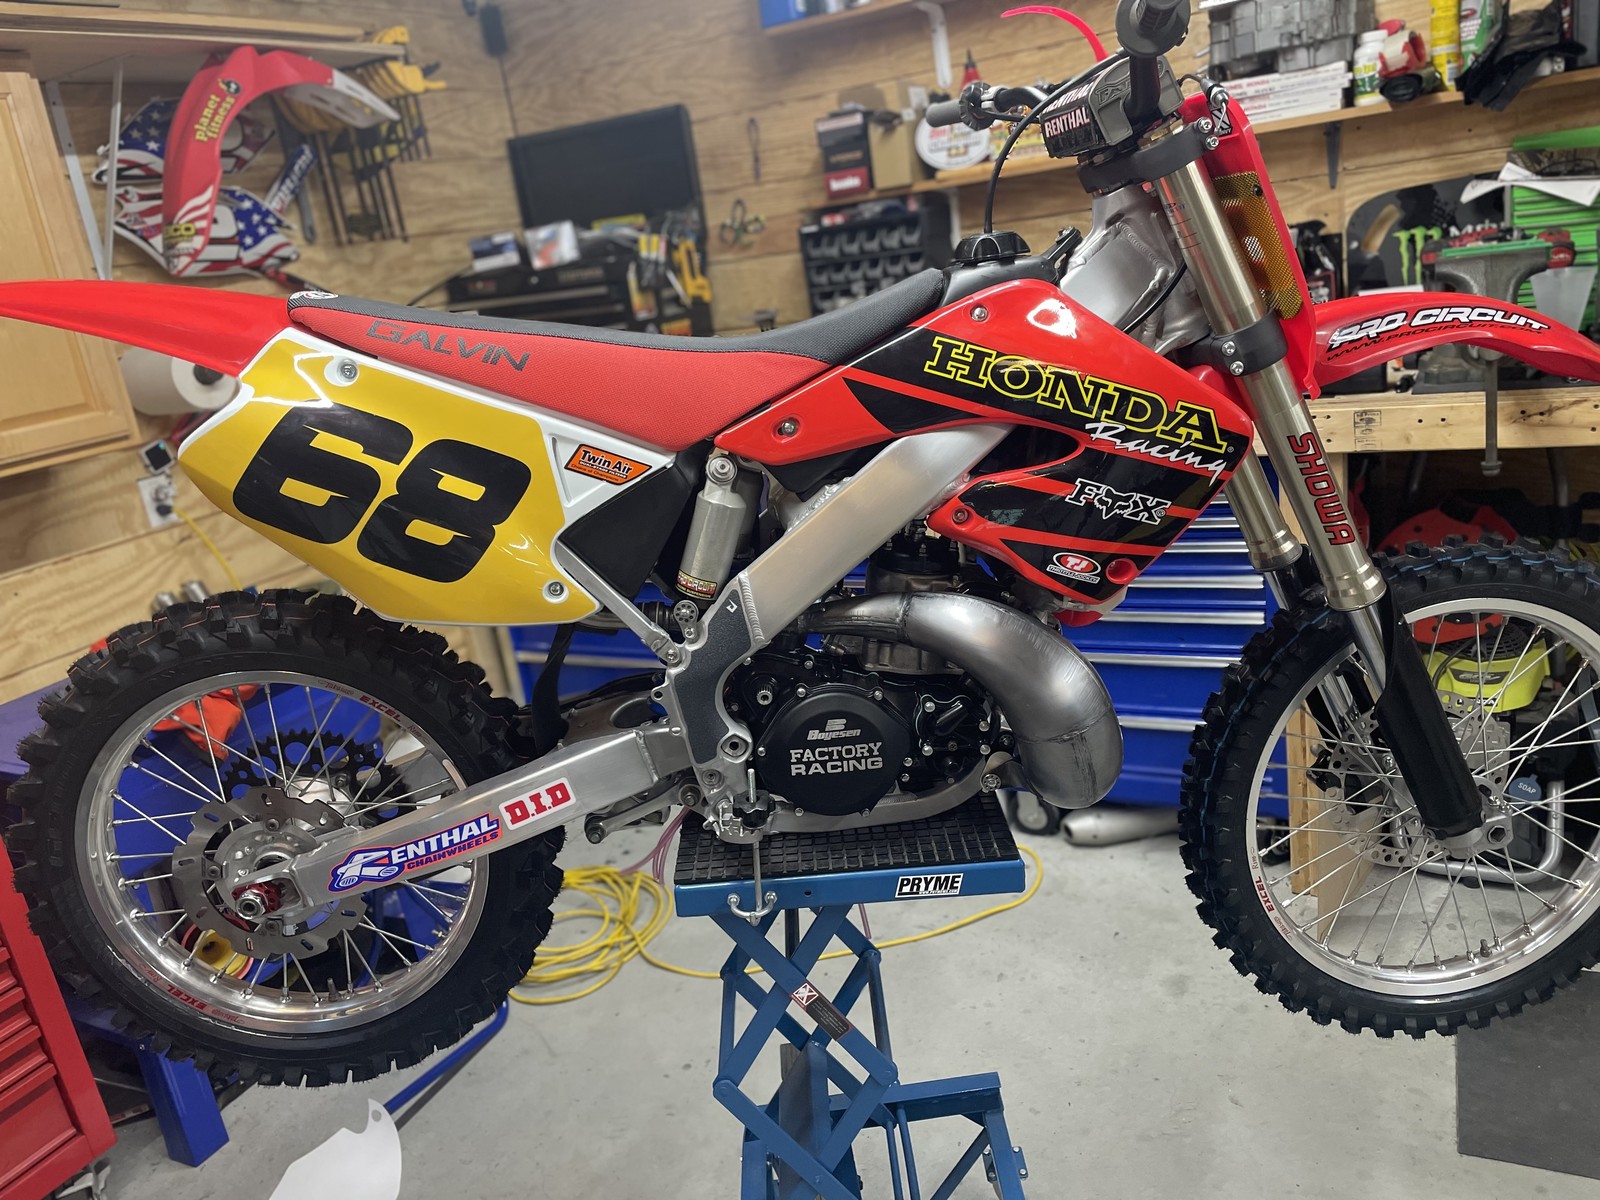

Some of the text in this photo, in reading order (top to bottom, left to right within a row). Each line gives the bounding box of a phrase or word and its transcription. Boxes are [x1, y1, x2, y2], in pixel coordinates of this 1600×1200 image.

[1044, 106, 1090, 138] RENTHAL
[1411, 307, 1549, 331] CIRCUIT
[366, 320, 530, 371] GALVIN
[924, 336, 1227, 453] HONDA
[581, 450, 633, 475] Twin Air
[1085, 422, 1229, 487] Racing
[232, 399, 532, 583] 68
[1287, 432, 1355, 545] SHOWA
[1066, 556, 1090, 570] TJ
[360, 695, 401, 722] EXCEL
[807, 729, 861, 741] Boyesen
[790, 742, 882, 762] FACTORY
[791, 757, 883, 776] RACING
[1517, 782, 1537, 795] SOAP
[504, 782, 572, 825] D.I.D
[337, 815, 499, 888] RENTHAL
[406, 831, 499, 870] CHAINWHEELS
[898, 874, 962, 893] PRYME
[1255, 876, 1275, 912] EXCEL
[166, 984, 208, 1010] EXCEL
